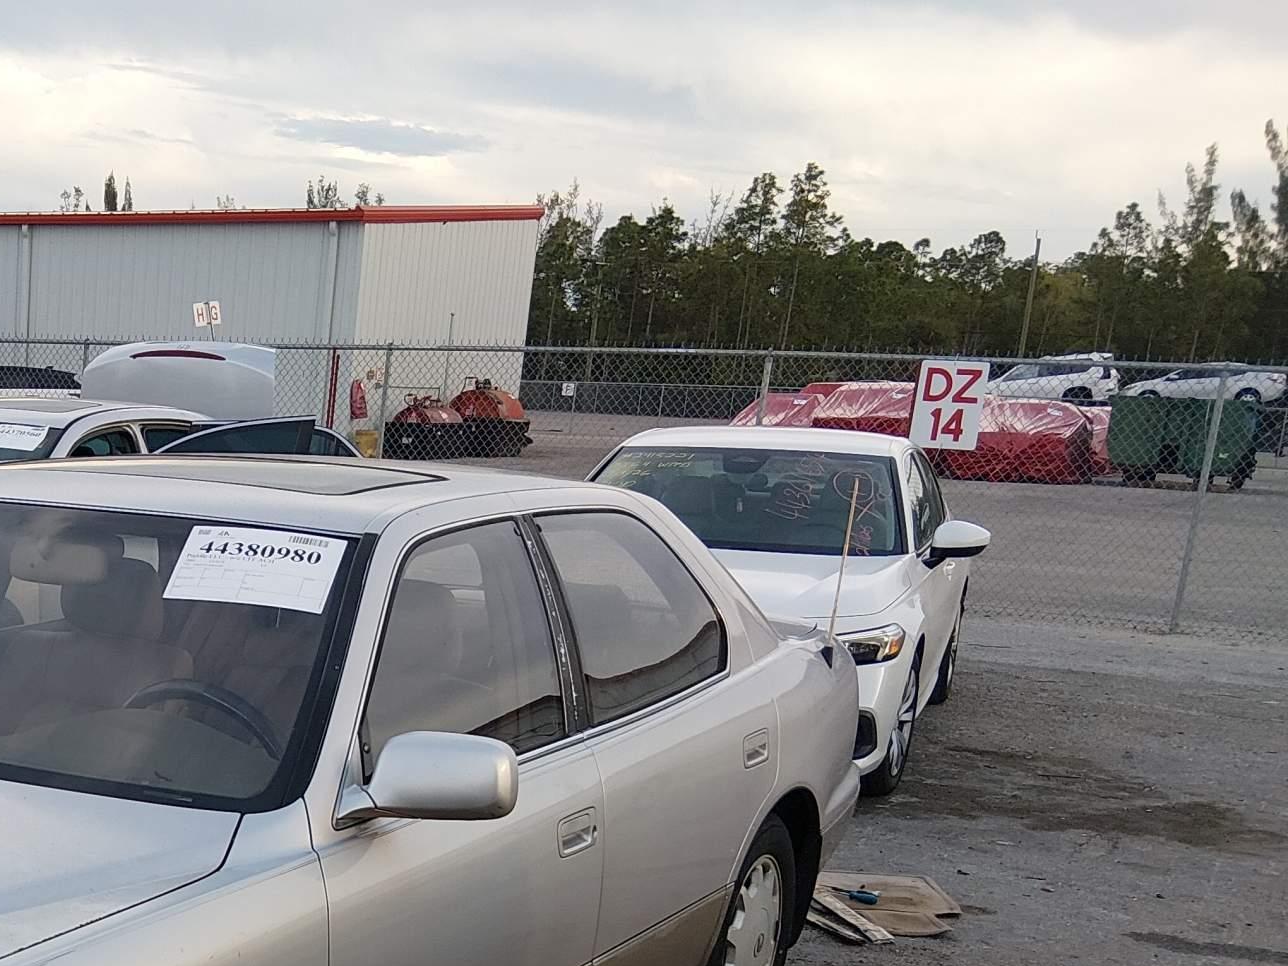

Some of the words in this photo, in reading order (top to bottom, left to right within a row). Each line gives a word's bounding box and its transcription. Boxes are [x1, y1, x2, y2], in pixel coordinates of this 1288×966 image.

[922, 367, 984, 404] DZ
[930, 407, 964, 442] 14
[199, 540, 322, 566] 44380980
